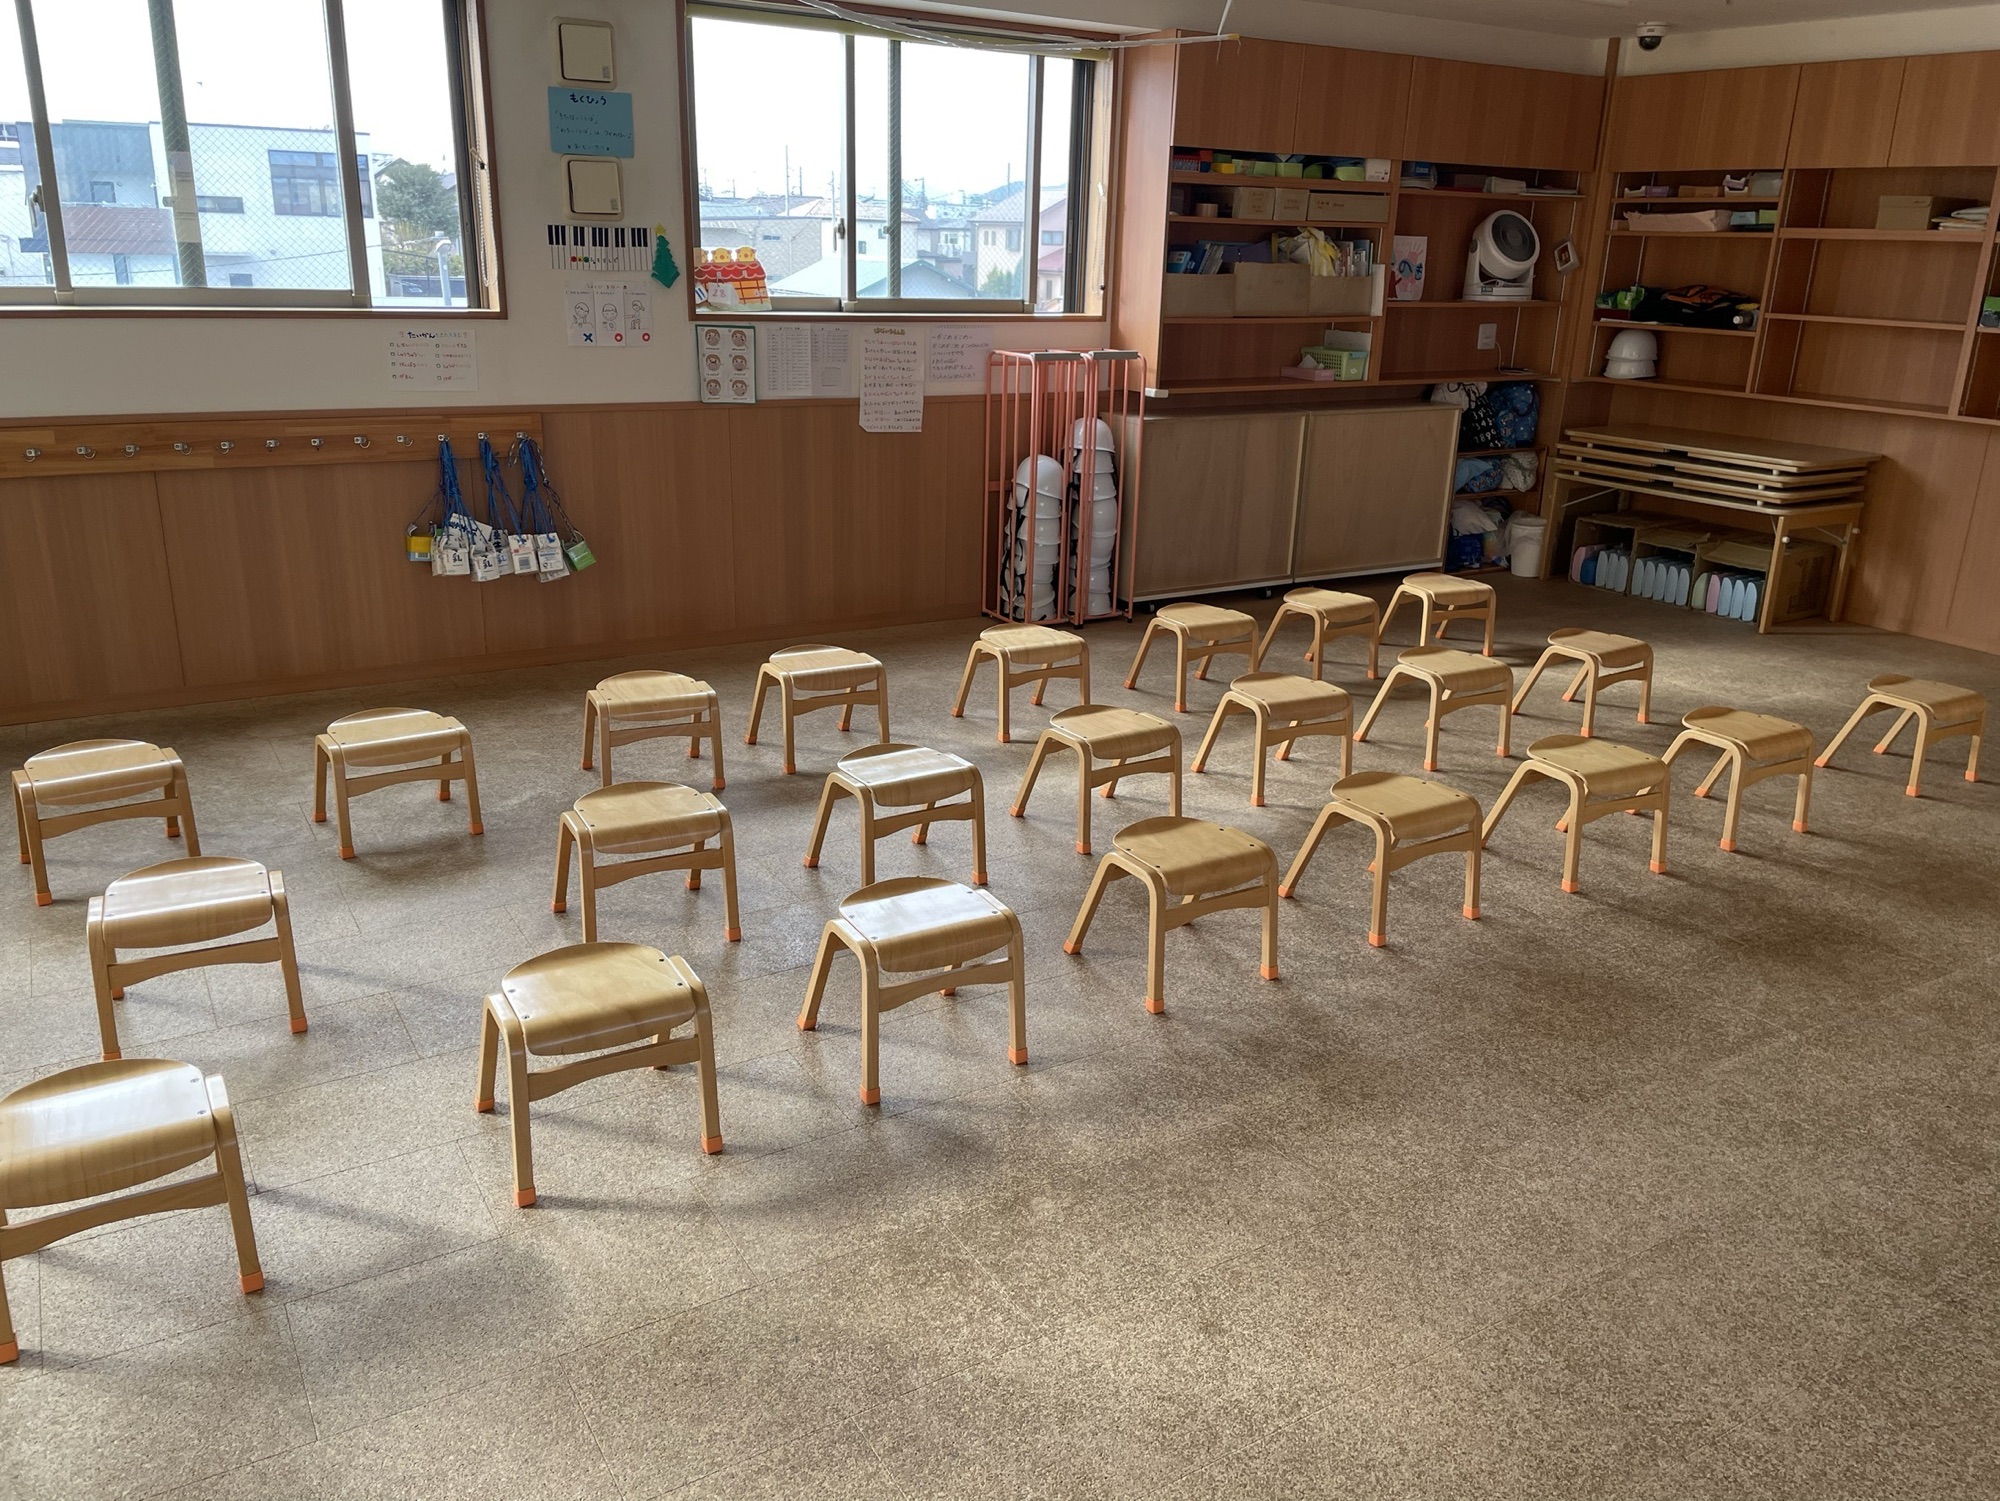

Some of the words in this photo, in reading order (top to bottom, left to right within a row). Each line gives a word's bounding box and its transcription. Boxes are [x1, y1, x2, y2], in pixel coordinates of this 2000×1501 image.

[569, 92, 607, 106] もくひょう
[712, 288, 726, 298] 28
